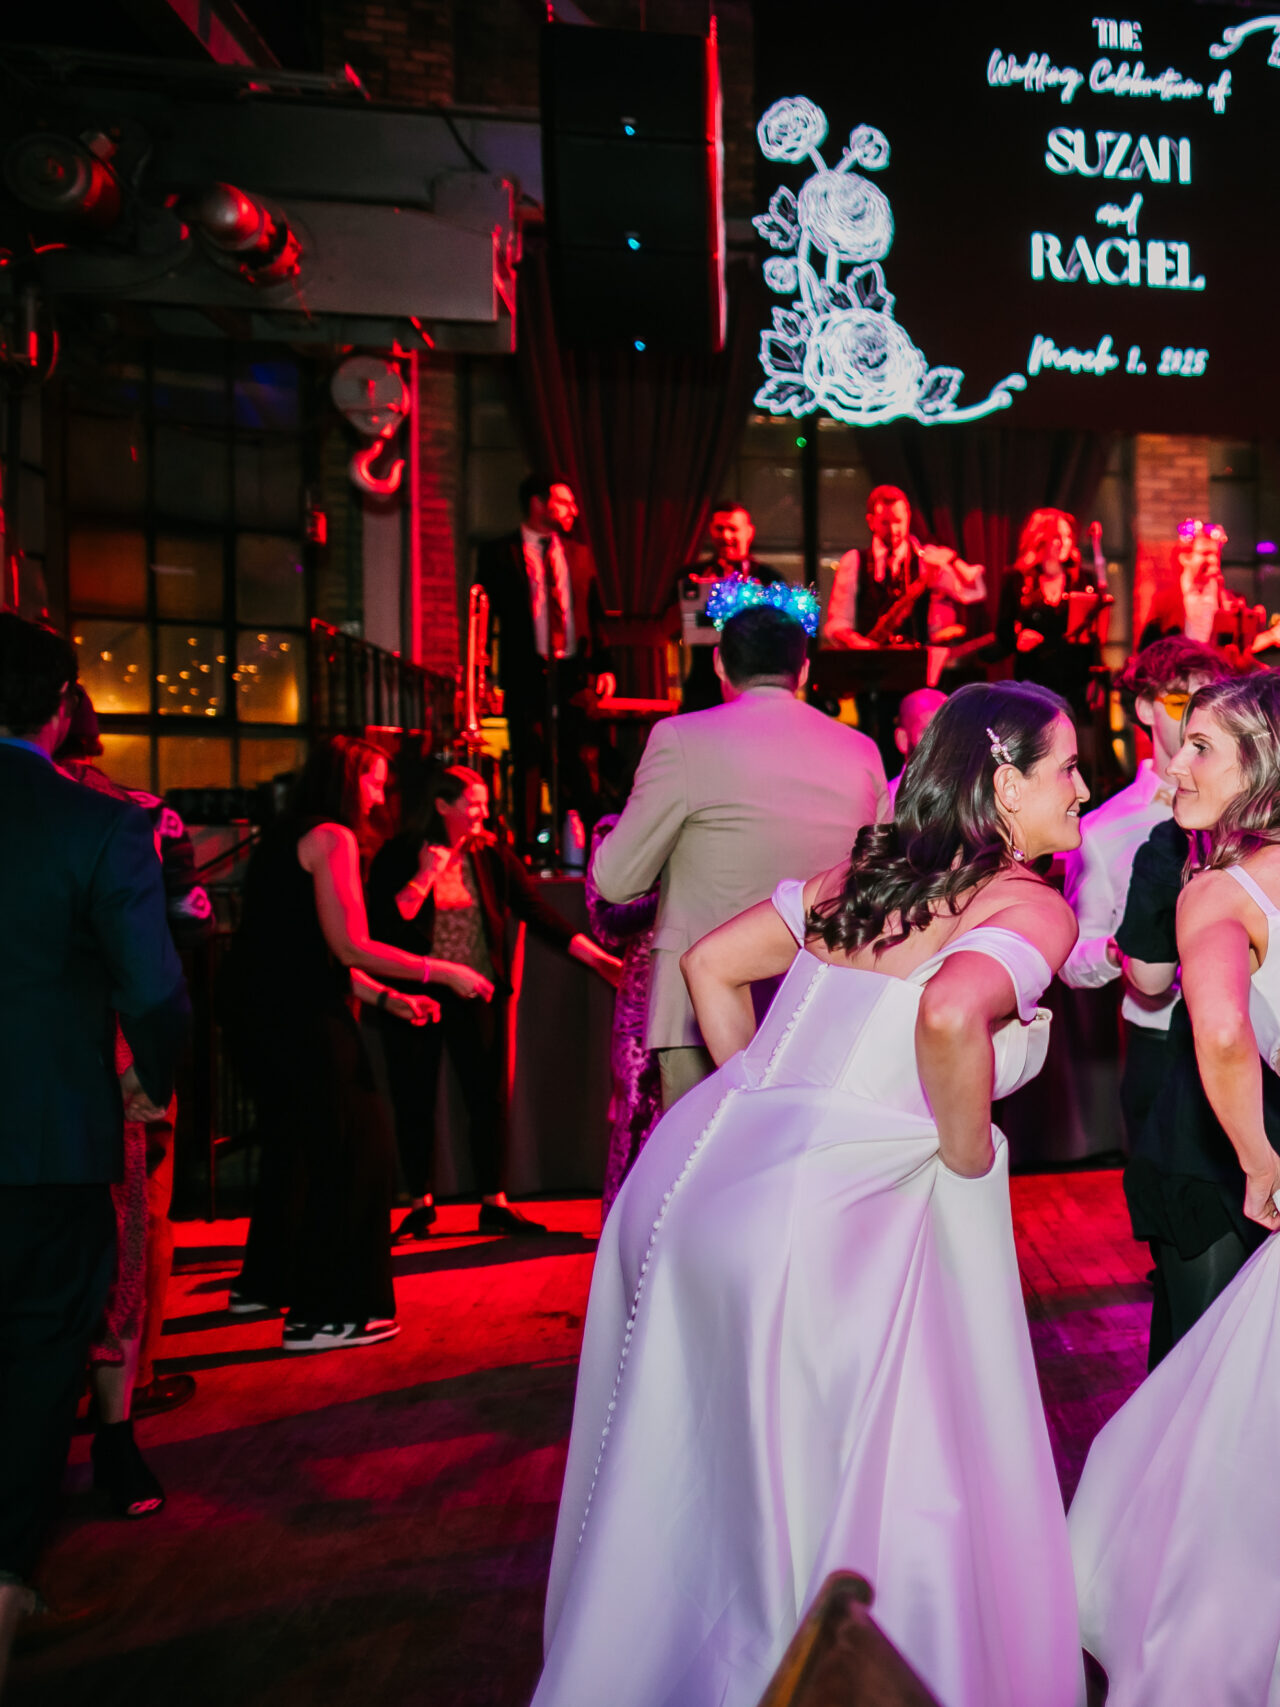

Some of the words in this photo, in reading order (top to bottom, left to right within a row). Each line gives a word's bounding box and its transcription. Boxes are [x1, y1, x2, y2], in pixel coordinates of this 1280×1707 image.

[1092, 17, 1142, 51] THE
[987, 49, 1084, 104] Wedding
[1089, 58, 1203, 101] Celebration
[1208, 70, 1232, 114] of
[1045, 127, 1191, 184] SUZAN
[1096, 193, 1143, 236] and
[1031, 231, 1206, 291] RACHEL
[1027, 334, 1119, 376] March
